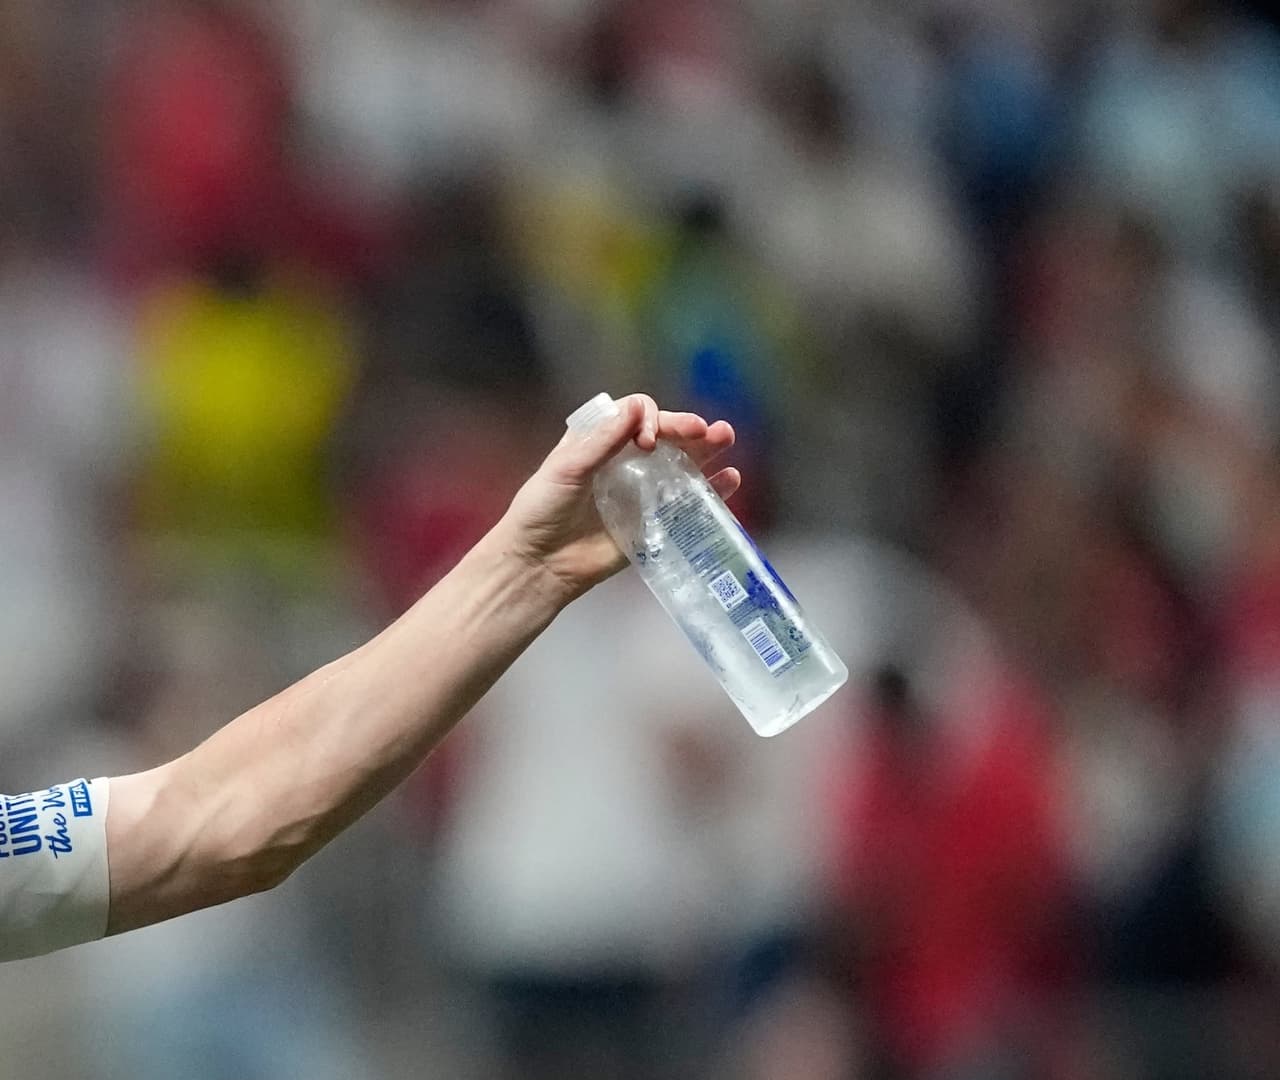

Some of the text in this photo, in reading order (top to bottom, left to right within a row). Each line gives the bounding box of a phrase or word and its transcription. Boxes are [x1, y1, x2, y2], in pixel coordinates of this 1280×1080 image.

[72, 783, 90, 814] FIFA
[5, 793, 42, 856] UNIT
[45, 812, 72, 860] the
